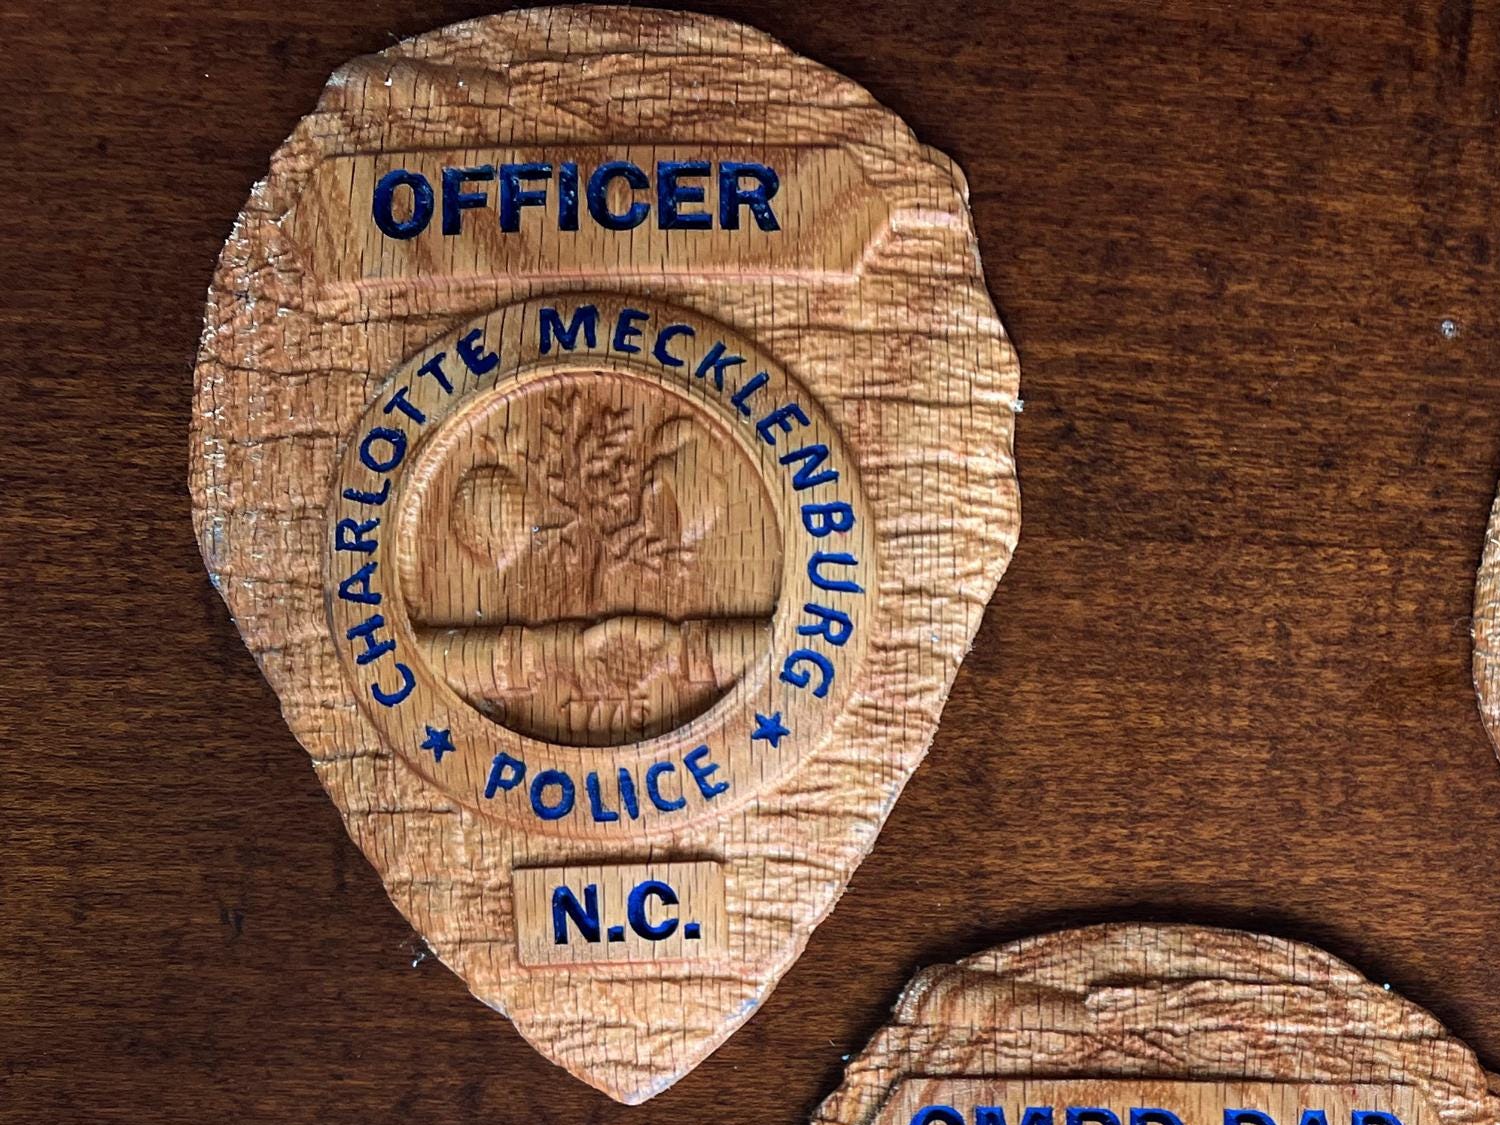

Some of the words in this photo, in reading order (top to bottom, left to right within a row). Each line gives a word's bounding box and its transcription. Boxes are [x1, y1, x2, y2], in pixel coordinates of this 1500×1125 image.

[371, 160, 782, 242] OFFICER
[334, 328, 501, 708] CHARLOTTE
[538, 305, 866, 700] MECKLENBURG
[483, 744, 732, 823] POLICE
[550, 878, 703, 945] N.C.
